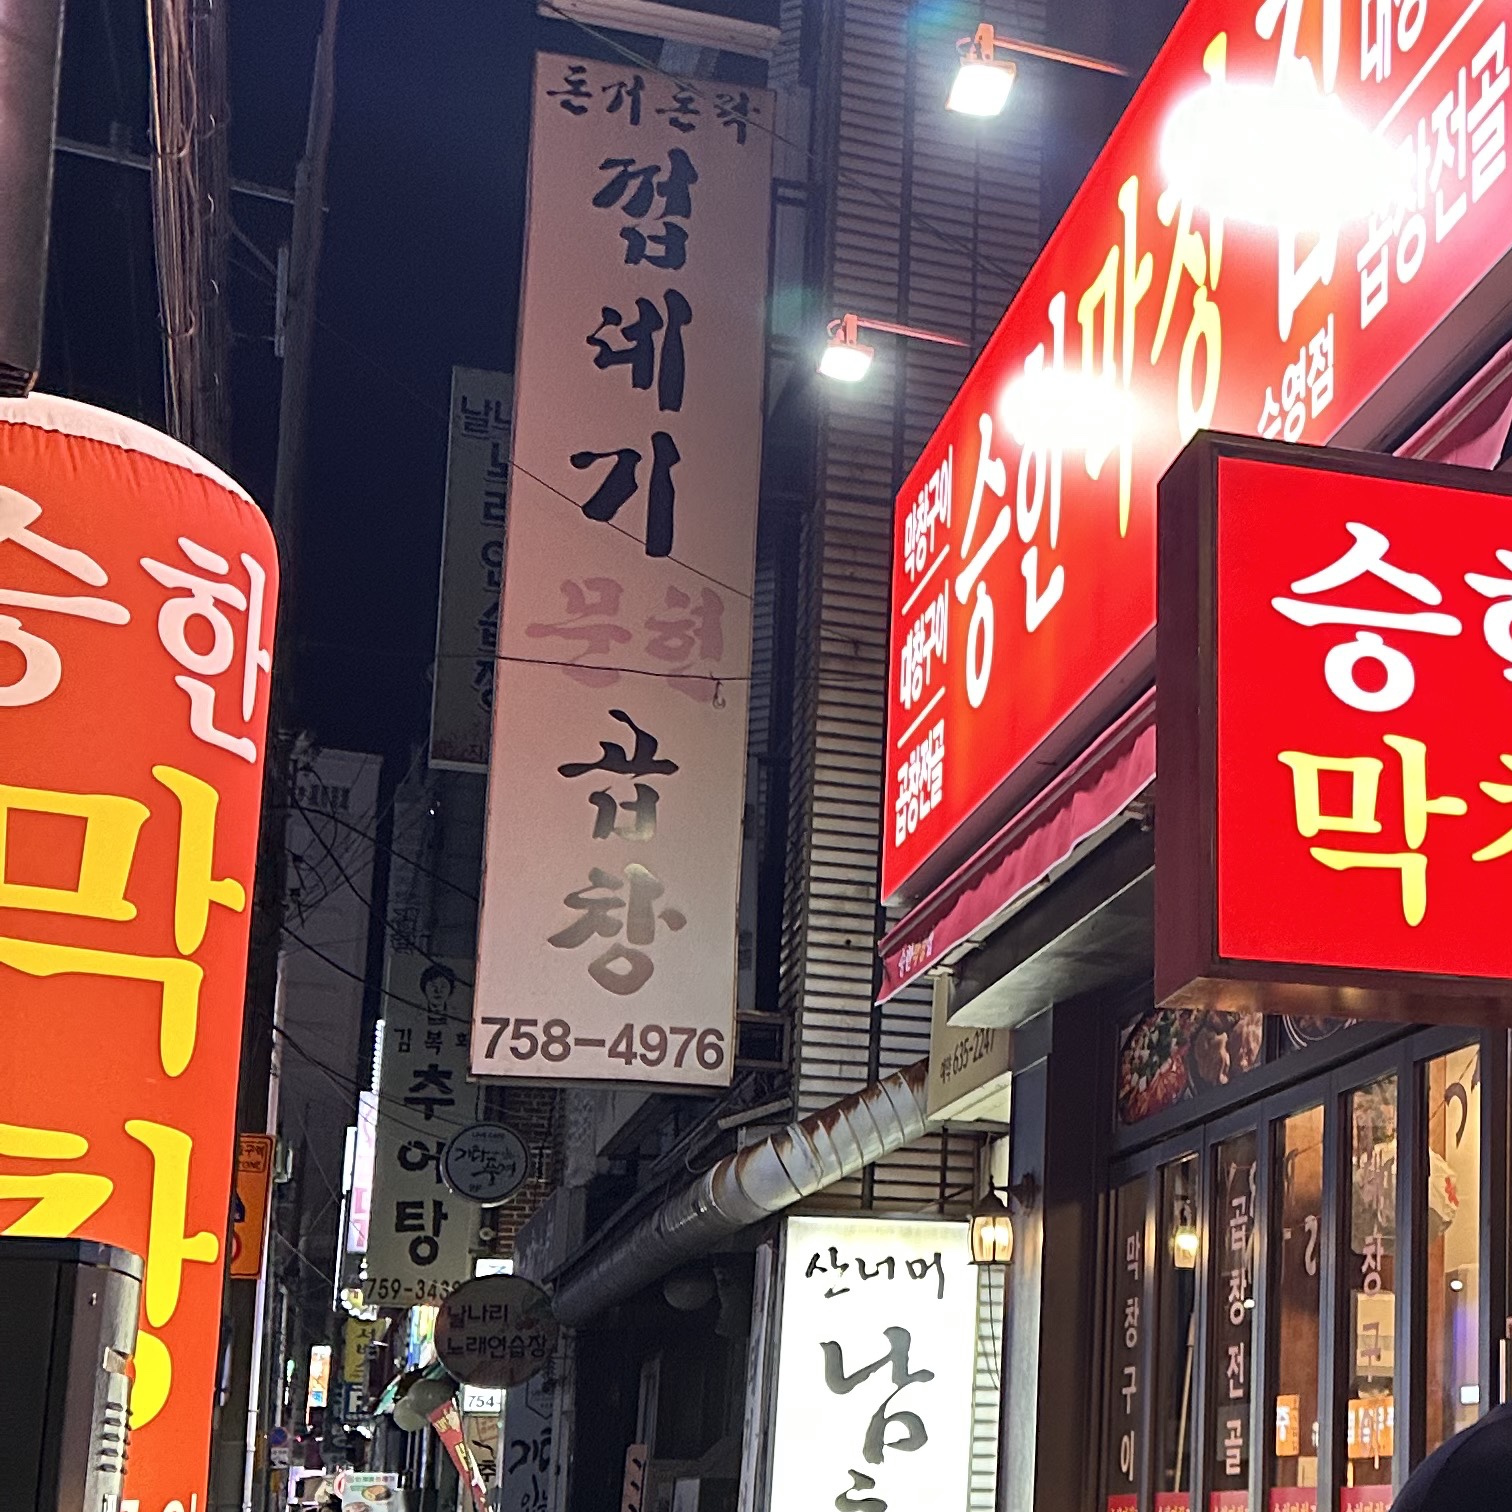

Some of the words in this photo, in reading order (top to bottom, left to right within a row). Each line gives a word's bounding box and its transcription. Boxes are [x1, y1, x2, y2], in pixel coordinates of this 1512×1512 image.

[904, 444, 953, 584] 막창구이
[899, 578, 949, 711] 대창구이
[895, 717, 946, 849] 곱창전골
[481, 1016, 725, 1070] 758-4976
[446, 1334, 547, 1359] 노래연습장
[1120, 1231, 1141, 1482] 막창구이
[1224, 1195, 1248, 1477] 곱창전골
